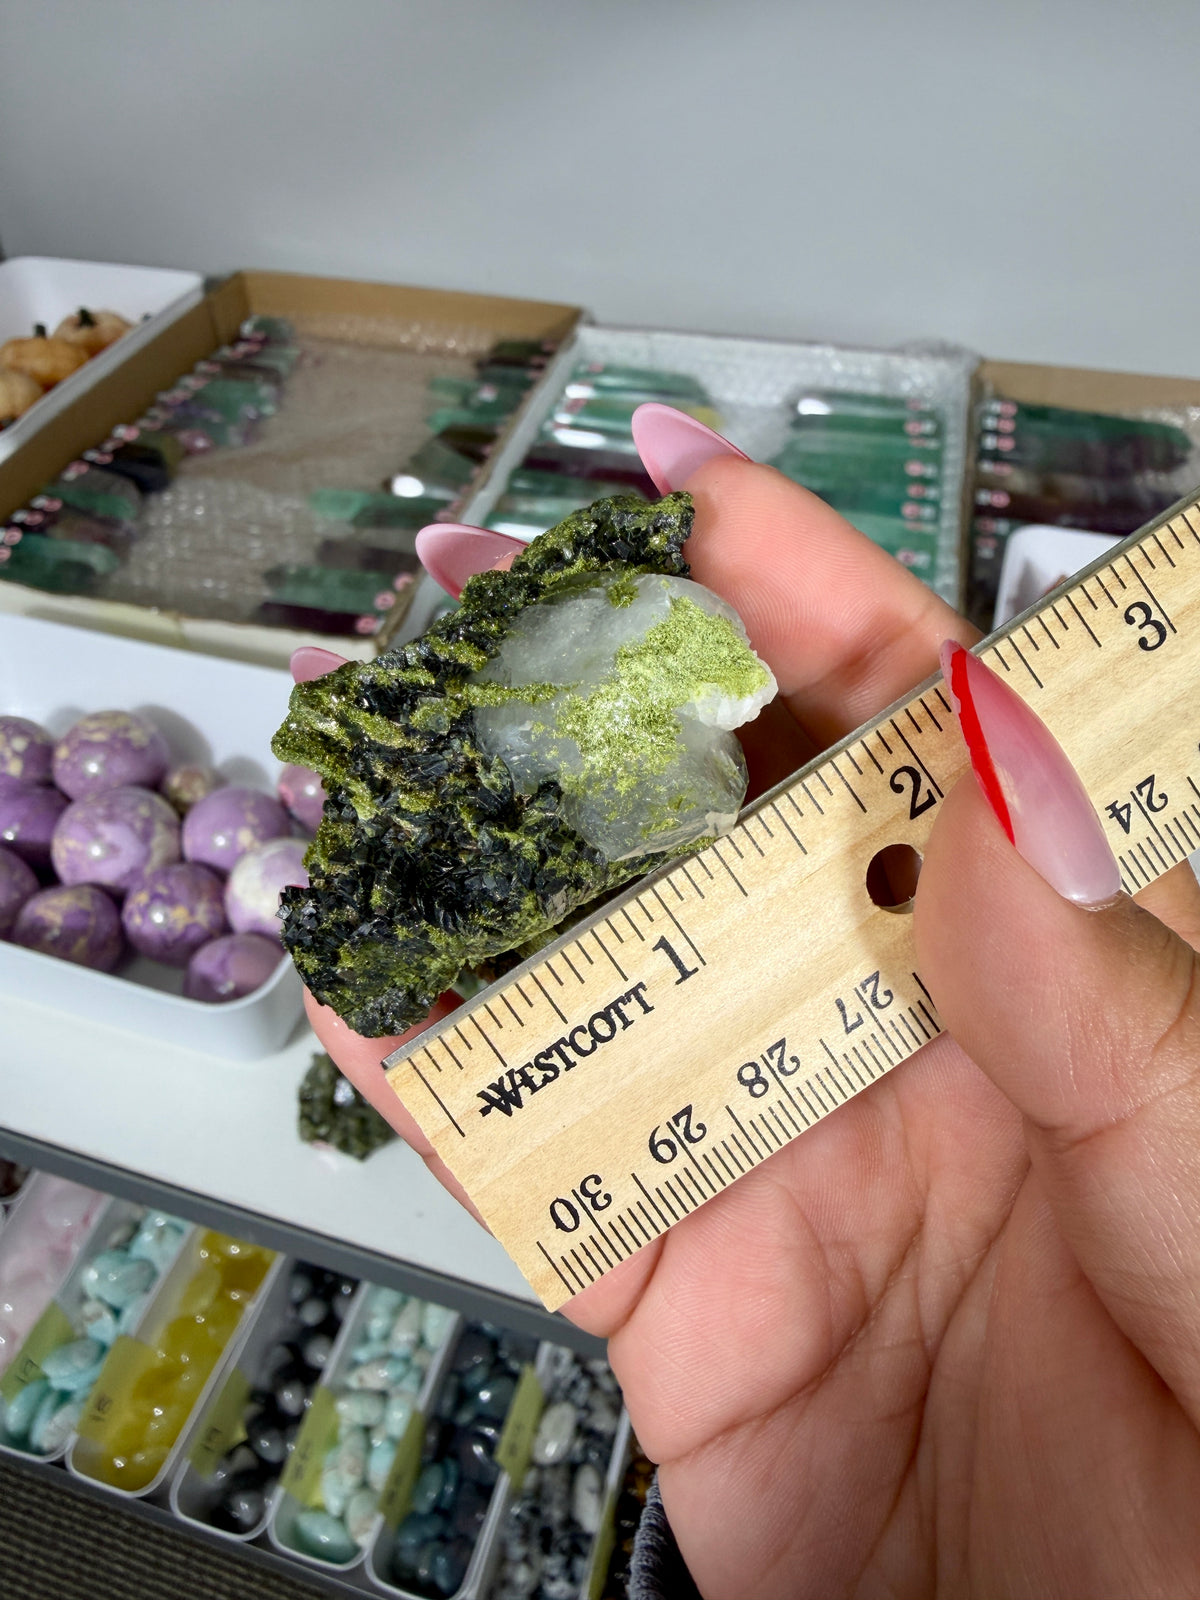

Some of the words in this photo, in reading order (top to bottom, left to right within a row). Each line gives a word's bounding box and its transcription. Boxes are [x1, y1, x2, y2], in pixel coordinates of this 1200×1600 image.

[1124, 601, 1167, 651] 3
[889, 765, 936, 820] 2
[1105, 774, 1168, 834] 24
[652, 936, 699, 985] 1
[835, 970, 893, 1035] 27
[477, 981, 655, 1117] WESTCOTT
[737, 1037, 801, 1099] 28
[648, 1104, 707, 1165] 29
[549, 1174, 612, 1233] 30
